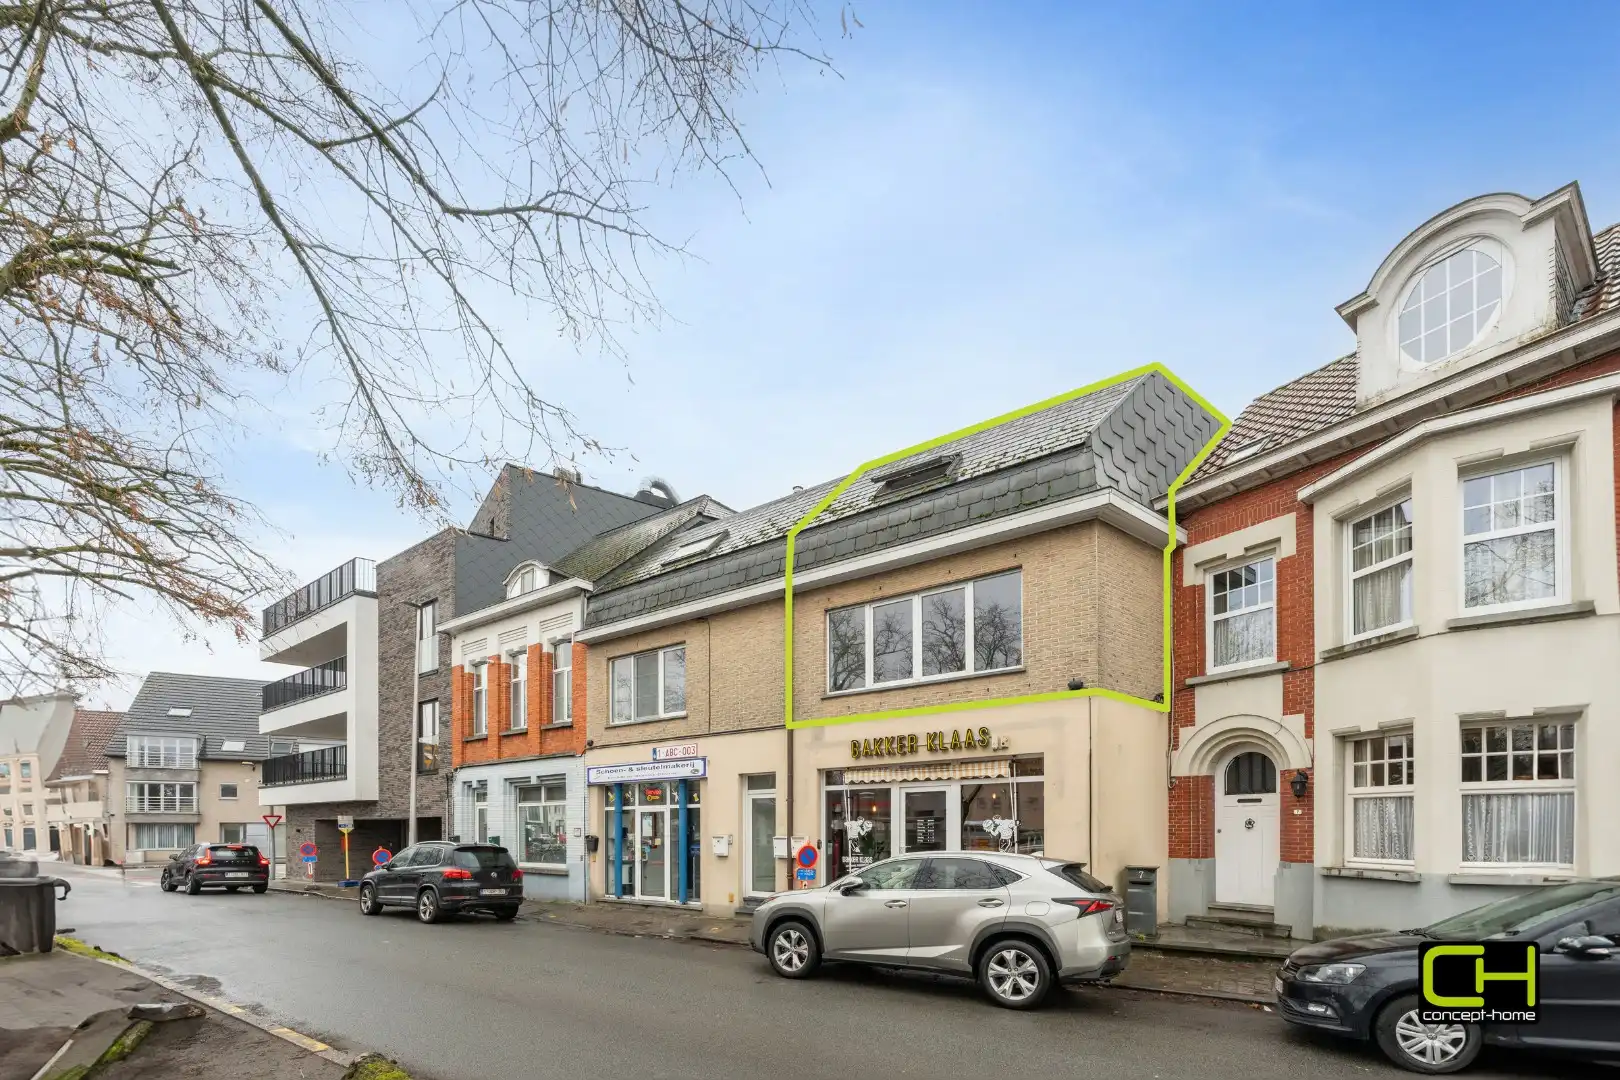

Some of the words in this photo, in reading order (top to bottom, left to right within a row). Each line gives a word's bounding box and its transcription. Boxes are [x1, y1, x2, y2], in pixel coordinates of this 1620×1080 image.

[850, 733, 918, 759] BAKKER
[926, 726, 989, 751] KLAAS
[636, 761, 695, 772] sleutelmakerij
[1138, 870, 1144, 878] 7
